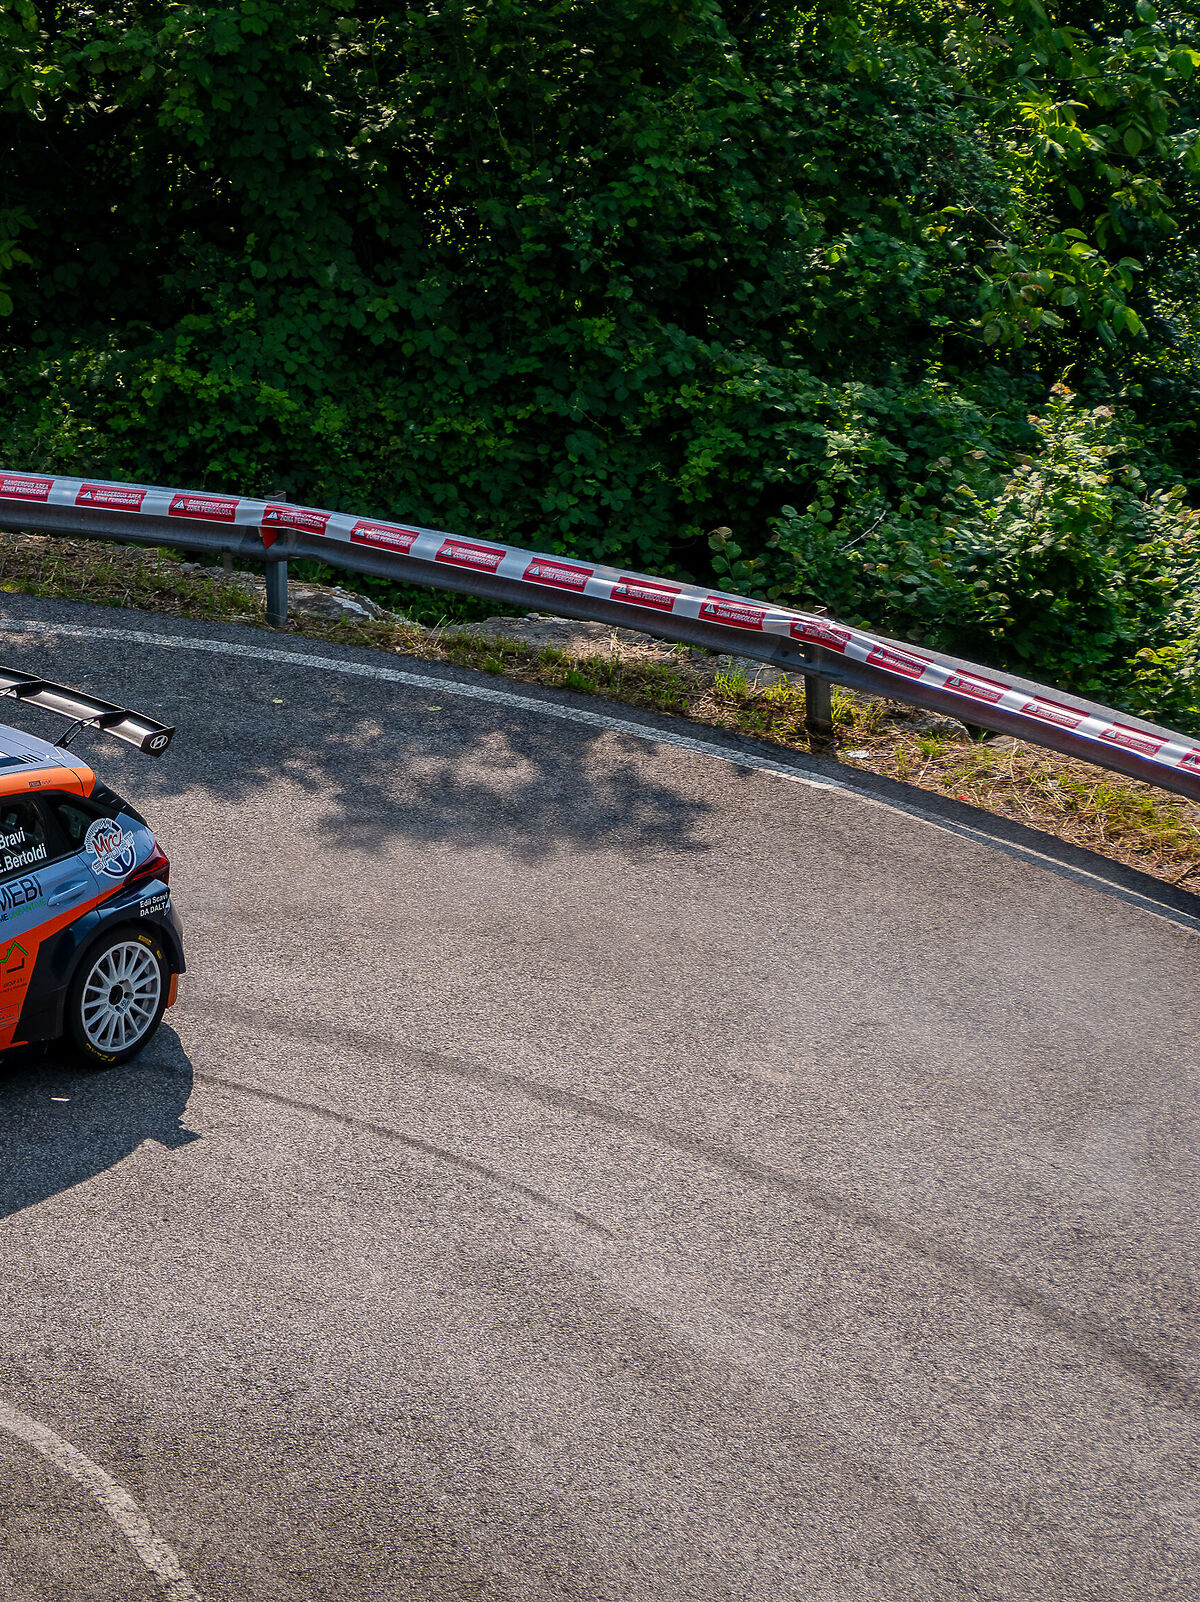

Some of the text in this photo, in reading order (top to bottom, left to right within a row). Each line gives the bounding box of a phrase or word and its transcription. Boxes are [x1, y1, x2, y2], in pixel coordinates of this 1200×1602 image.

[15, 486, 47, 495] PERICOLOSA
[642, 592, 672, 604] PERICOLOSA
[730, 611, 760, 624] PERICOLOSA
[140, 908, 149, 917] DA
